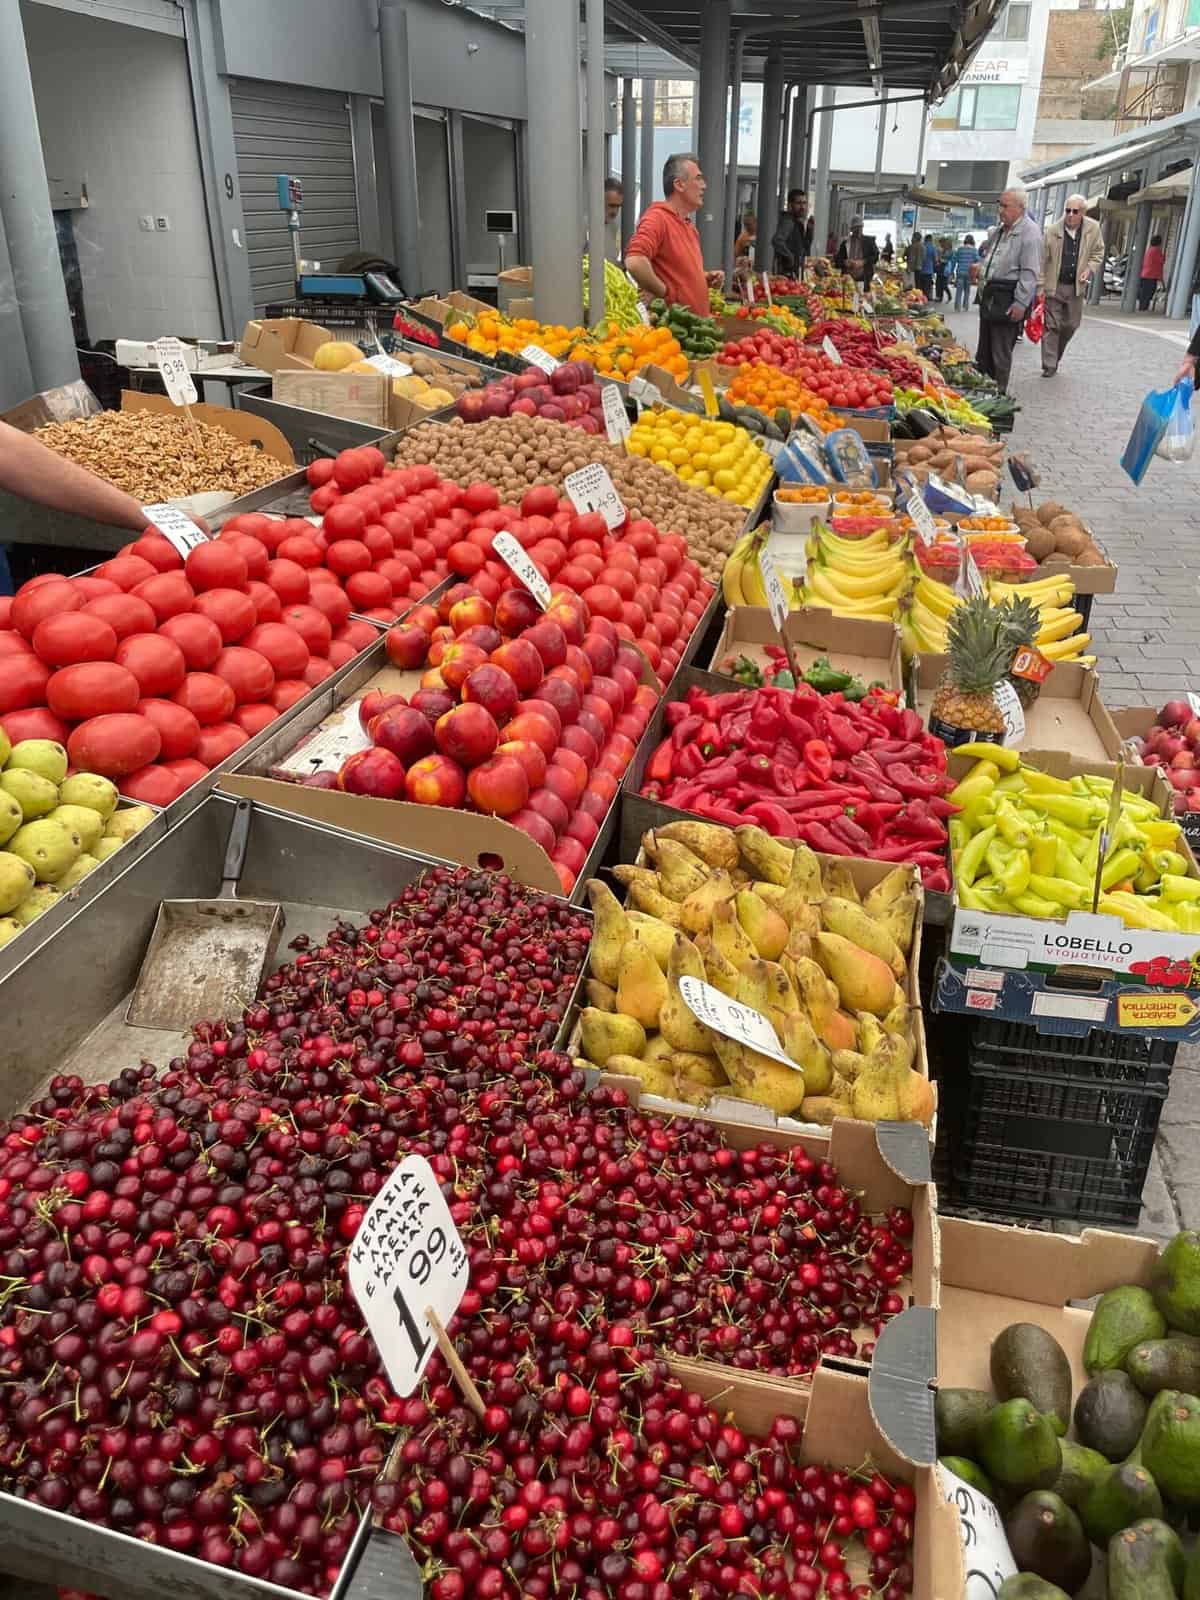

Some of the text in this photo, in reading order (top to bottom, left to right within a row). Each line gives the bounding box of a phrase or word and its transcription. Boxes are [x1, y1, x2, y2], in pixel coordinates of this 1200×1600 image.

[224, 173, 234, 200] 9
[1043, 934, 1133, 955] LOBELLO
[353, 1171, 415, 1264] ΚΕΡΑΣΙΑ
[371, 1181, 426, 1263] ΛΑΜΙΑΣ
